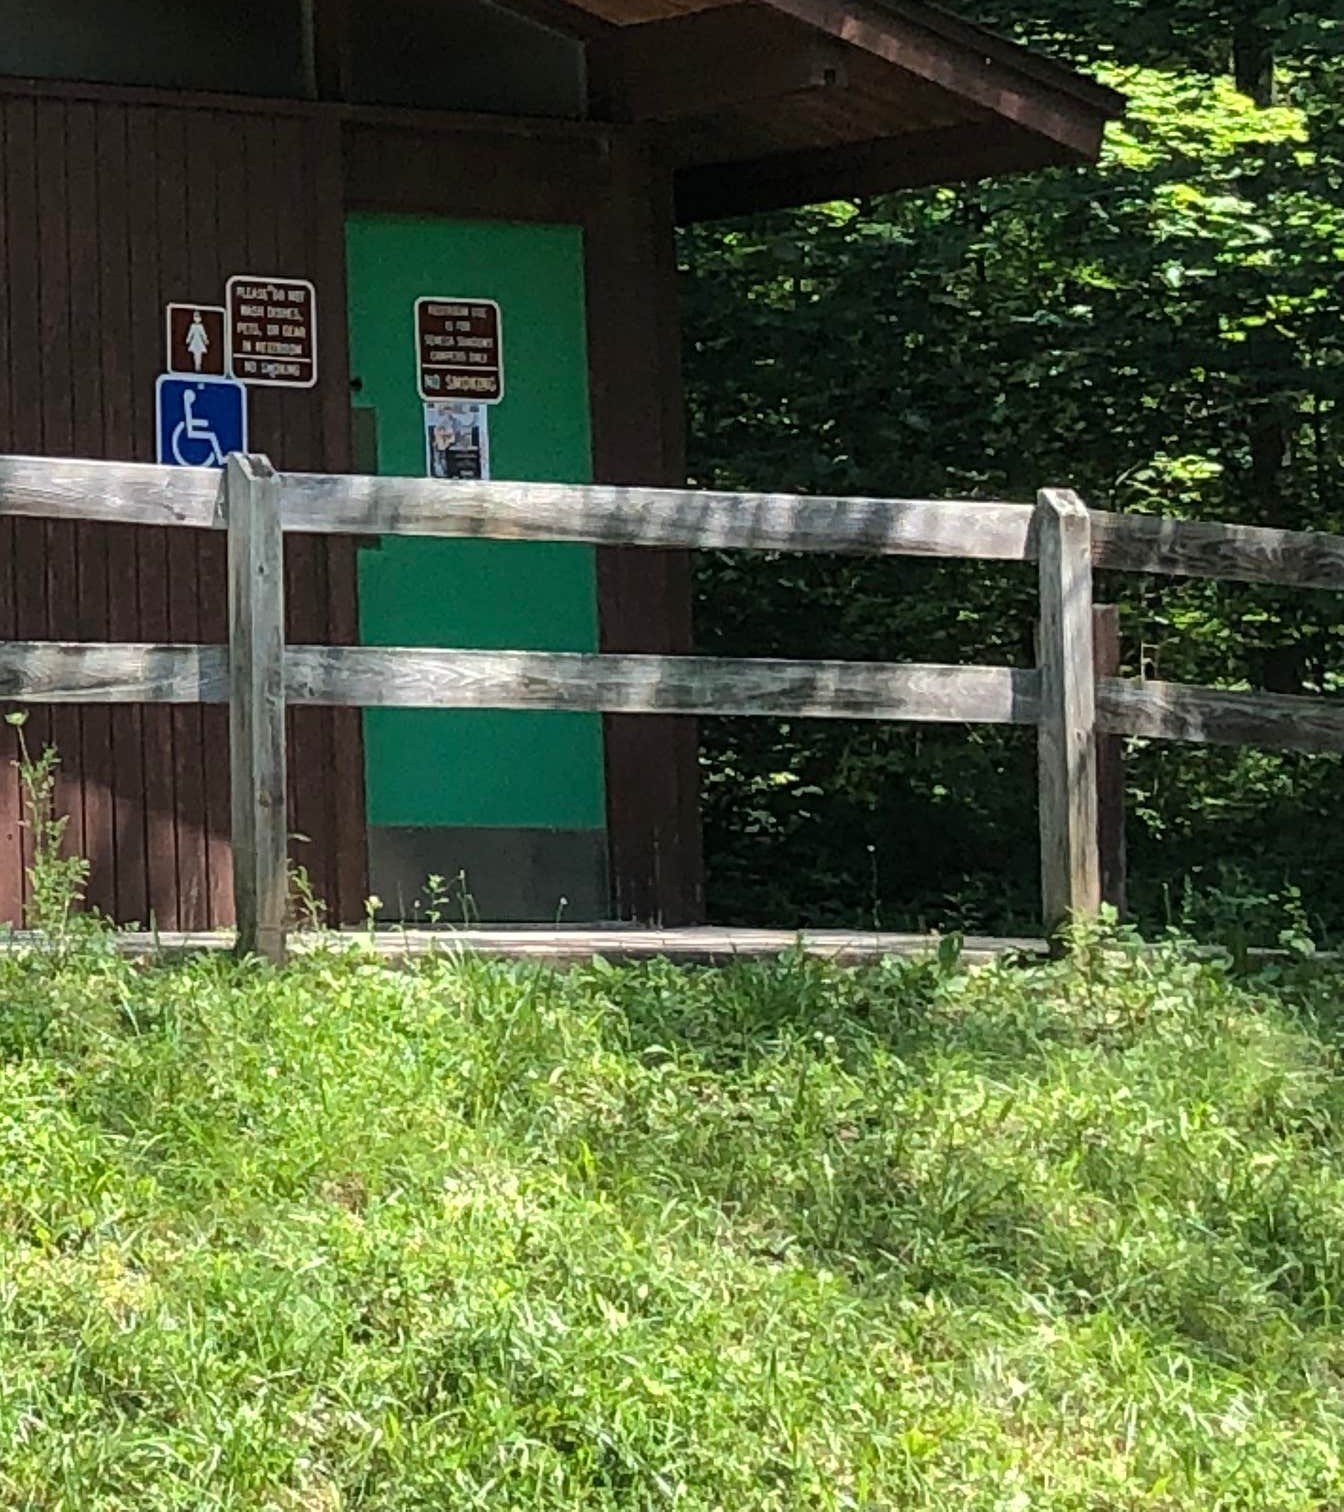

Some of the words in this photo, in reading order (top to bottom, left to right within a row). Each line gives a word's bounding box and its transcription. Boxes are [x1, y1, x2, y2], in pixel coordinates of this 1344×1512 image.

[245, 361, 256, 372] NO
[424, 374, 440, 389] NO
[445, 375, 496, 392] SMOKING
